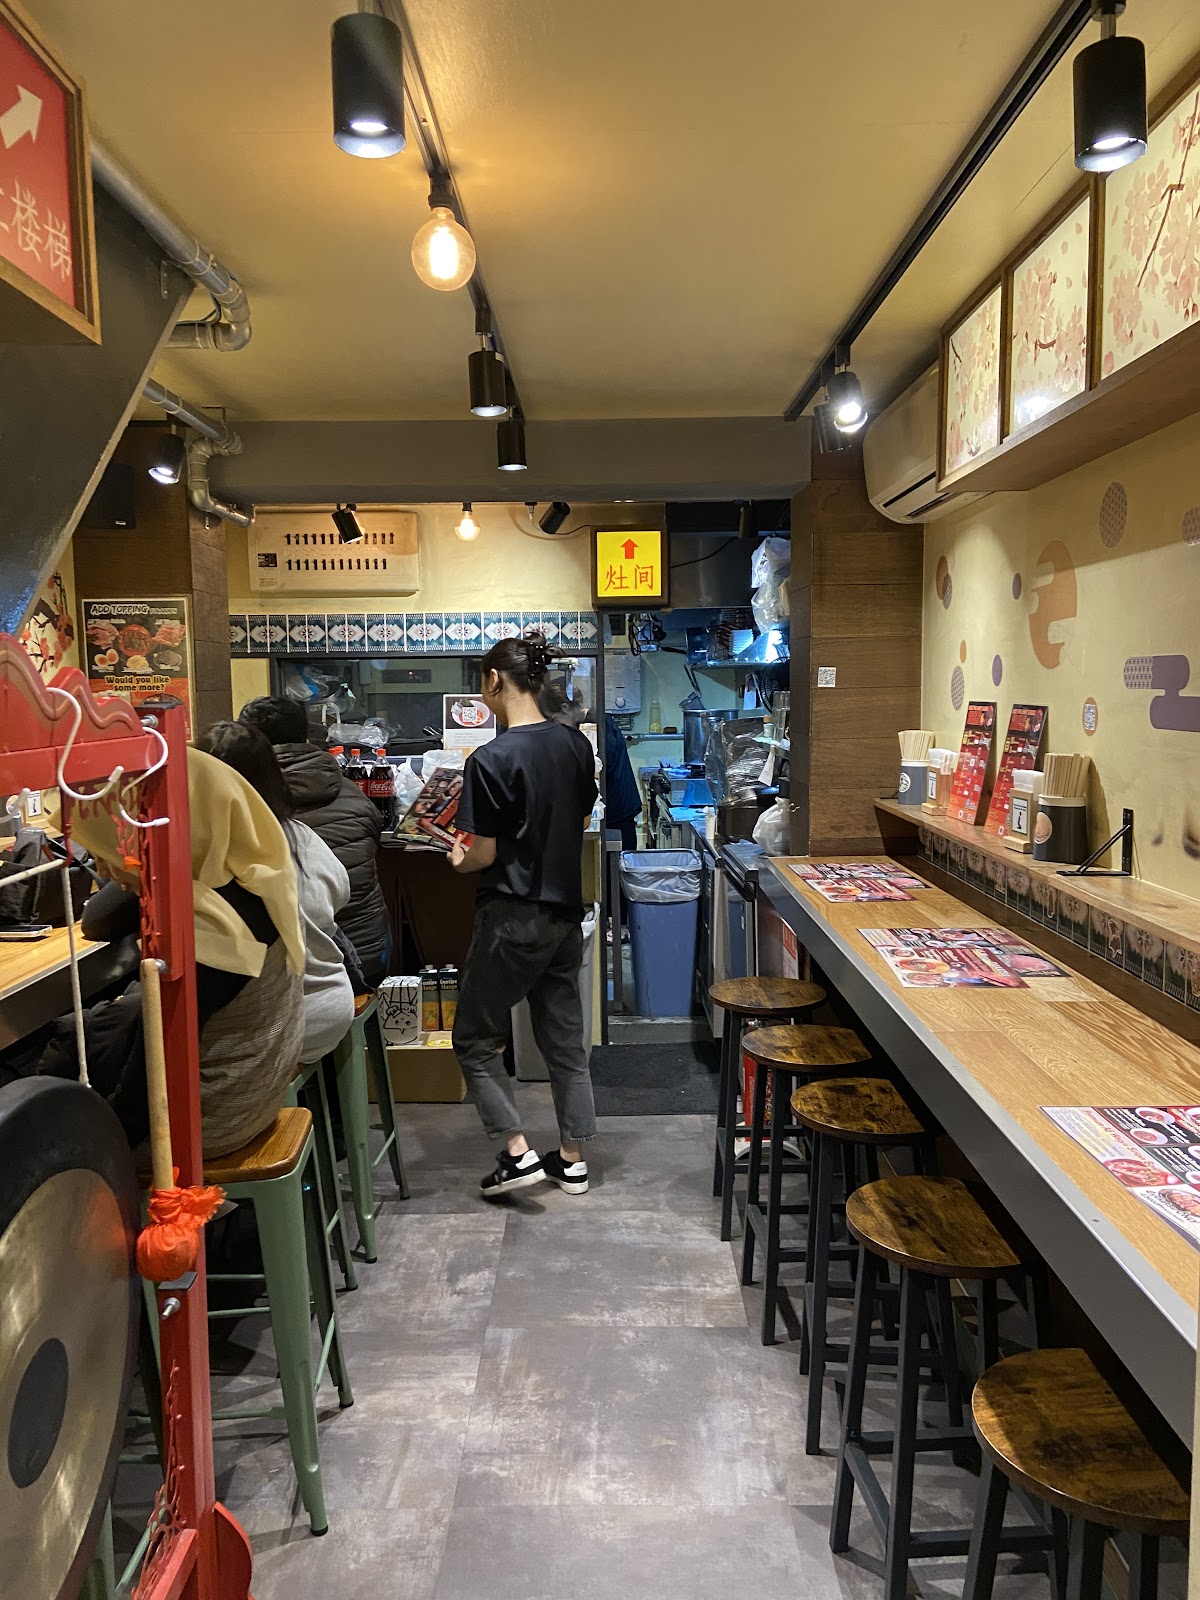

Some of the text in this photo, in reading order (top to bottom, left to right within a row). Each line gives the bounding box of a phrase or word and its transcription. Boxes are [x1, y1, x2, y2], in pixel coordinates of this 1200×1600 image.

[604, 564, 653, 591] 灶间
[91, 604, 110, 615] ADD
[111, 604, 149, 615] TOPPING
[106, 676, 133, 684] Would
